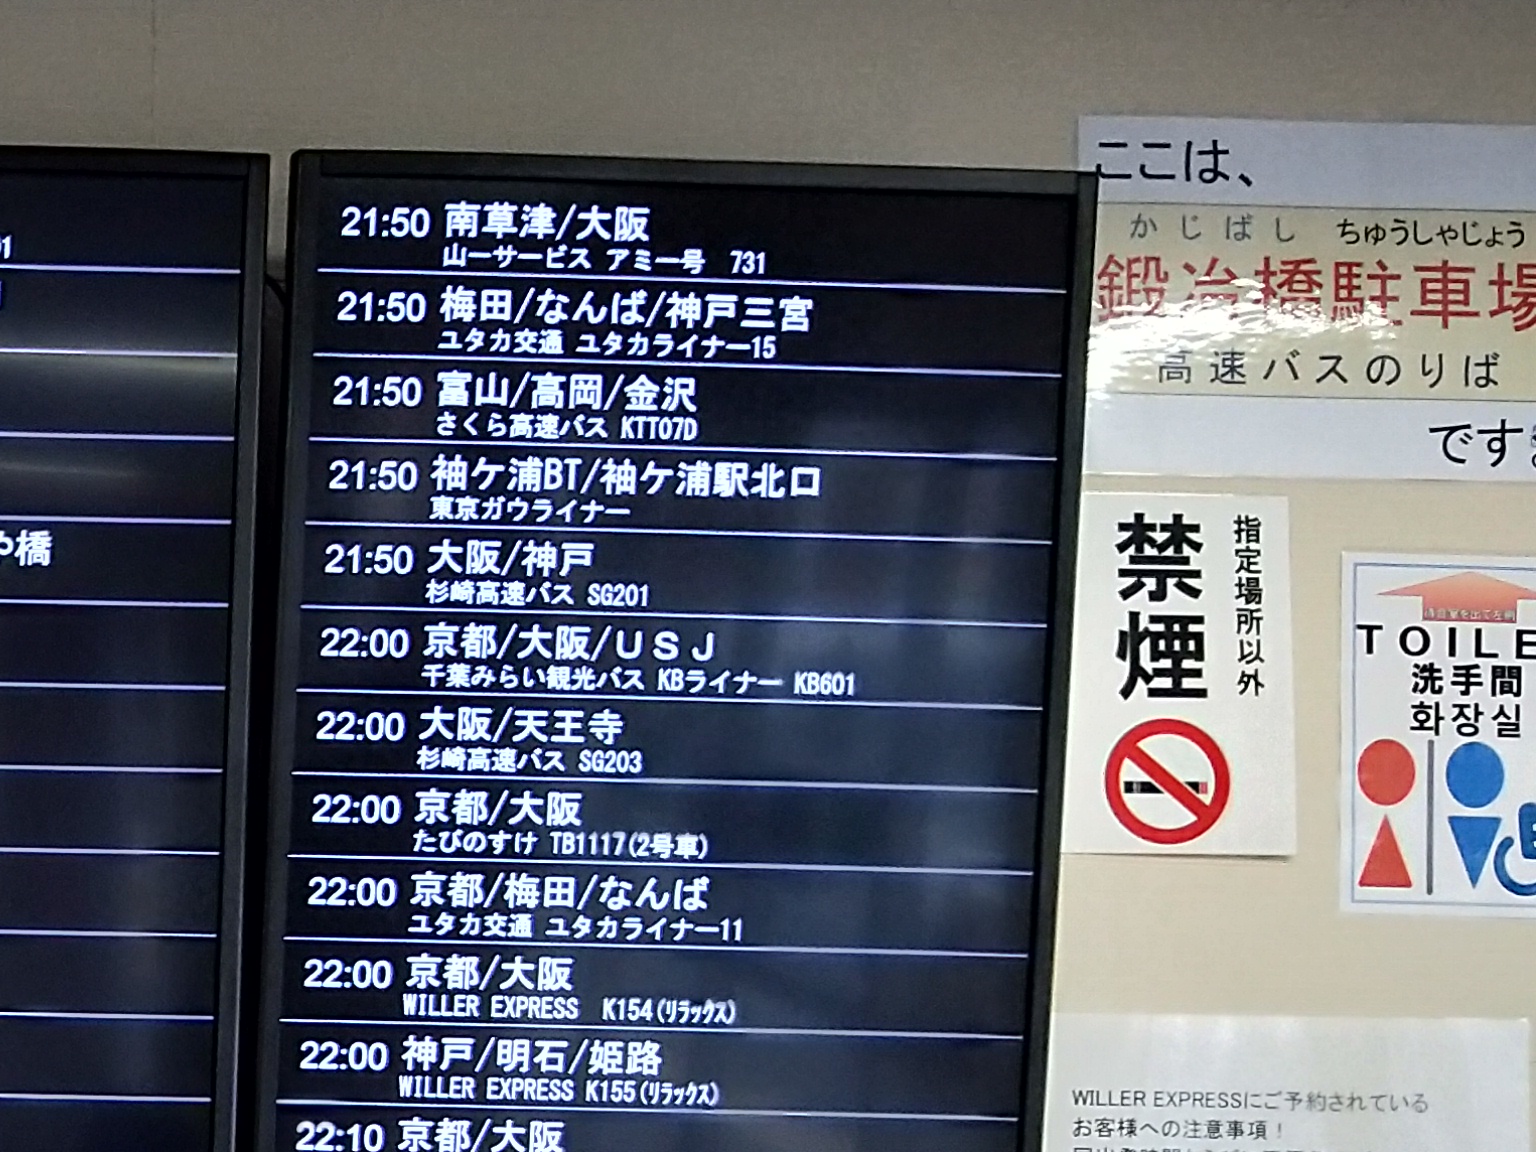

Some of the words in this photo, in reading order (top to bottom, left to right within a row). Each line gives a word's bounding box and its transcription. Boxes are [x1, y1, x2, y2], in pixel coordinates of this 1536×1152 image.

[1096, 139, 1253, 187] ここは、
[1337, 219, 1526, 249] ちゅうしゃじょう
[337, 292, 425, 323] 21:50
[440, 285, 814, 332] 梅田/なんば/神戸三宮
[438, 328, 564, 355] ユタカ交通
[576, 332, 776, 359] ユタカライナー15
[1158, 348, 1500, 389] 高速バスのりば
[333, 376, 421, 407] 21:50
[436, 370, 696, 413] 富山/高岡/金沢
[436, 413, 609, 439] さくら高速バス
[1115, 512, 1209, 700] 禁煙
[1233, 514, 1265, 696] 指定場所以外
[1411, 662, 1522, 697] 洗手間
[1410, 701, 1521, 738] 화장실
[1072, 1090, 1146, 1107] WILLER
[1154, 1090, 1429, 1113] EXPRESSにご予約されている
